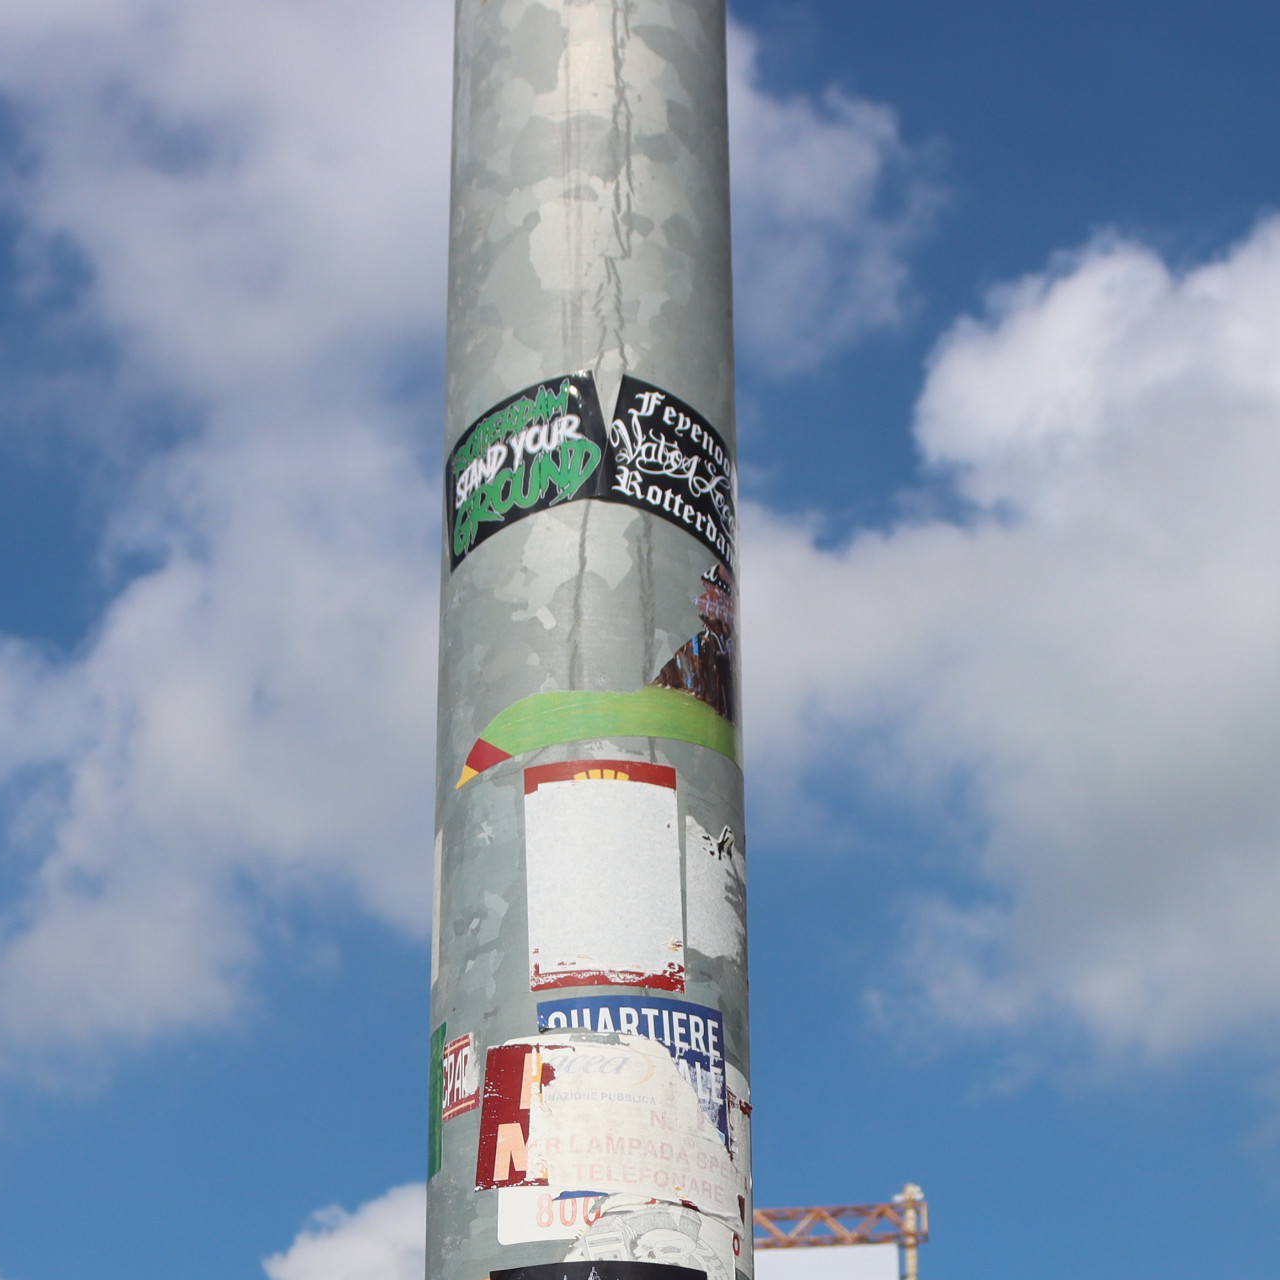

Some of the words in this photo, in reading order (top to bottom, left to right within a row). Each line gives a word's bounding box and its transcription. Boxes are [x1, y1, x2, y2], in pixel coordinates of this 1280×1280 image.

[456, 444, 508, 509] STAND
[510, 414, 584, 472] YOUR
[454, 438, 601, 556] GROUND
[548, 1006, 720, 1057] QUARTIERE
[601, 1091, 657, 1106] PUBBLICA
[570, 1136, 690, 1166] LAMPADA
[572, 1162, 724, 1202] TELEFONARE
